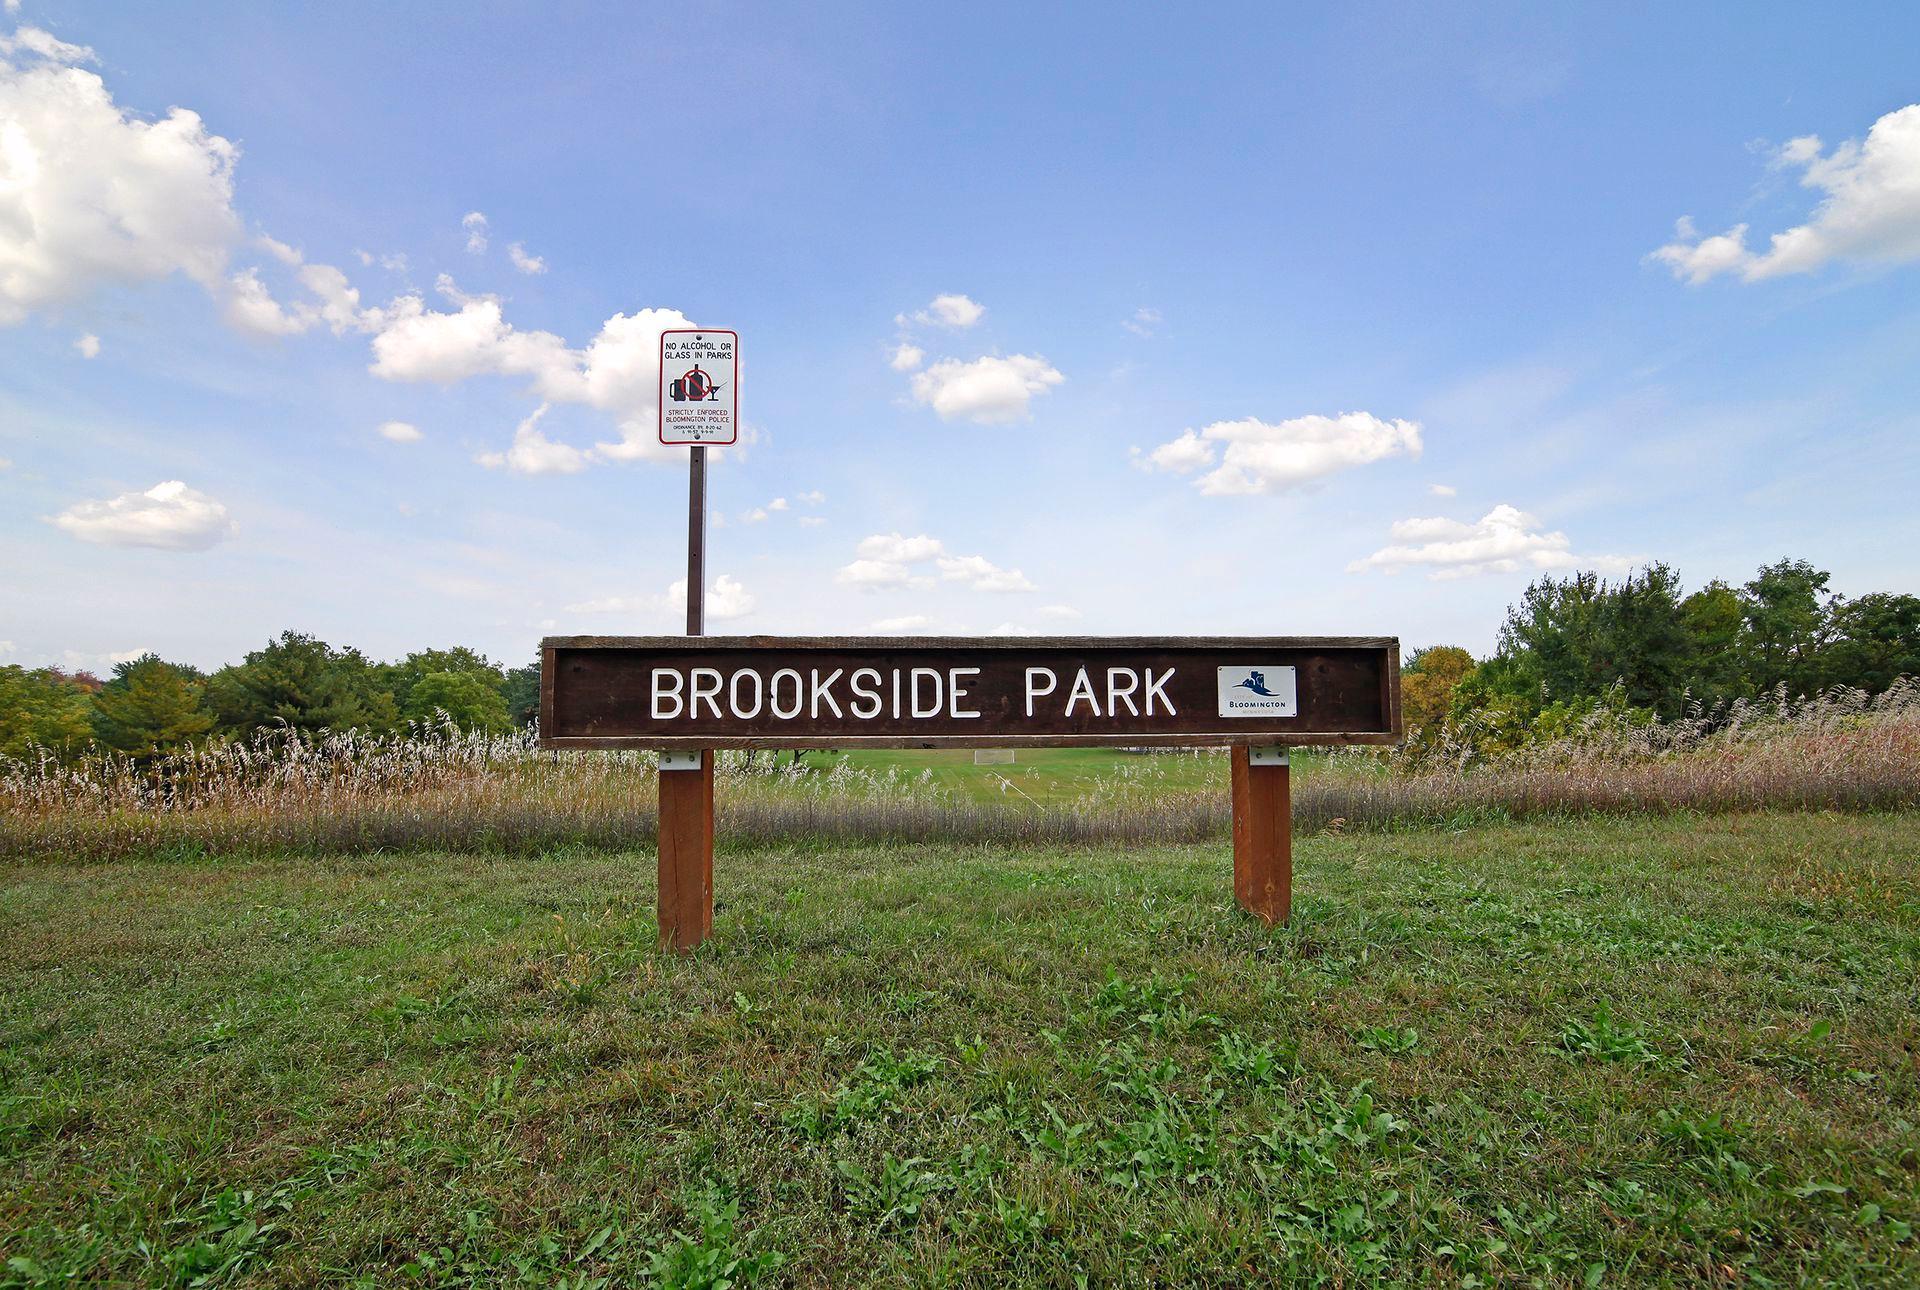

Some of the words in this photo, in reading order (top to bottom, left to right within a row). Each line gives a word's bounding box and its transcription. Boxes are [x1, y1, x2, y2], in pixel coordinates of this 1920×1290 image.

[665, 342, 677, 350] NO
[680, 342, 716, 350] ALCOHOL
[720, 342, 732, 350] OR
[664, 351, 691, 360] GLASS
[694, 351, 703, 359] IN
[706, 351, 732, 360] PARKS
[651, 667, 981, 720] BROOKSIDE
[1025, 666, 1177, 718] PARK
